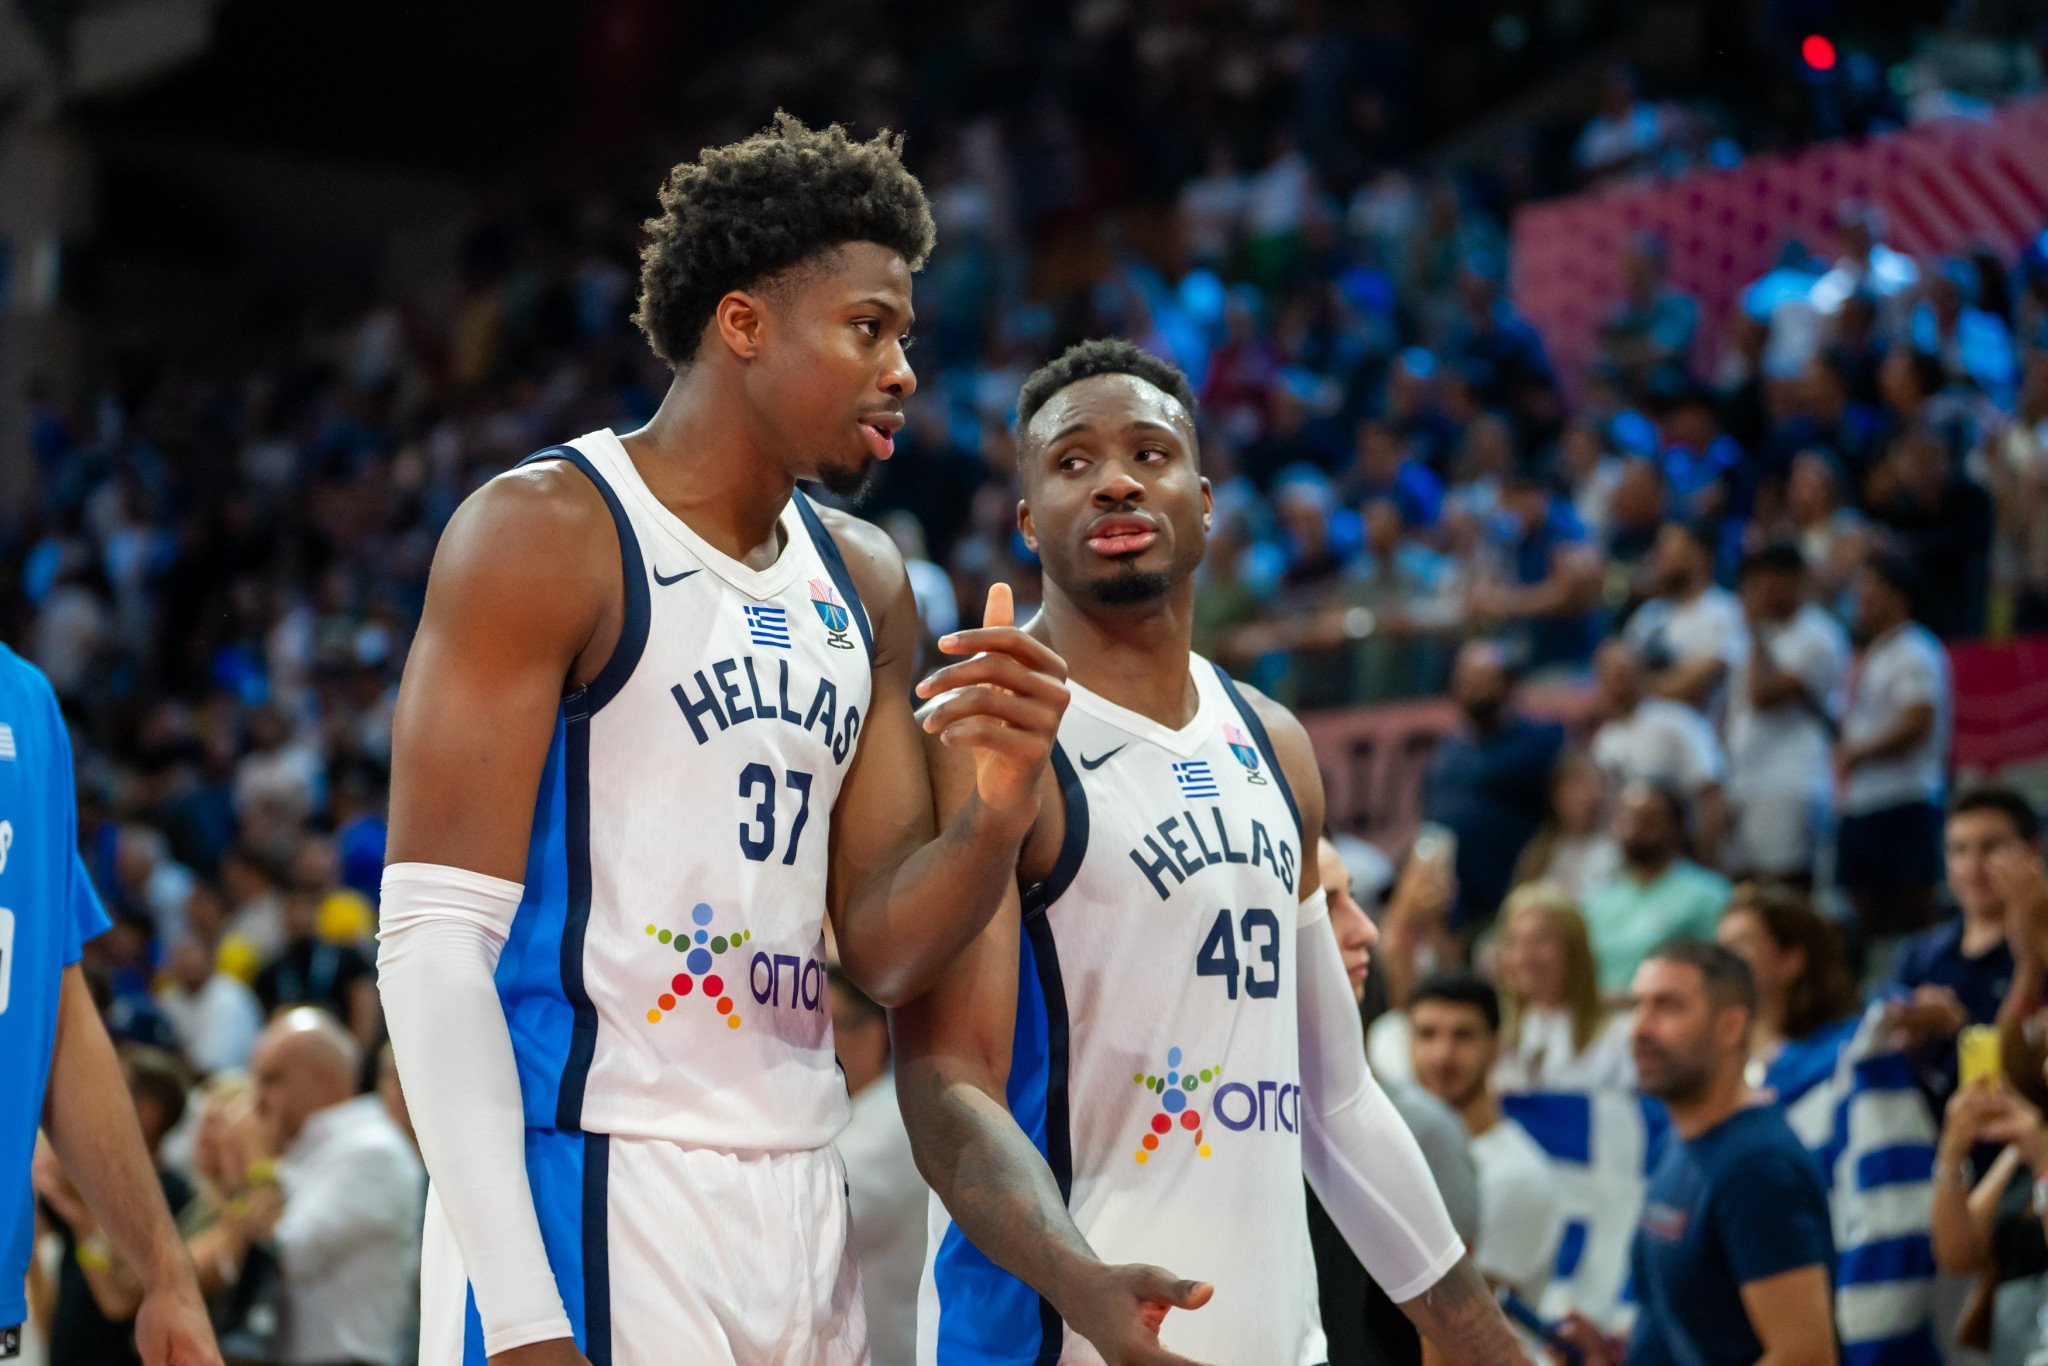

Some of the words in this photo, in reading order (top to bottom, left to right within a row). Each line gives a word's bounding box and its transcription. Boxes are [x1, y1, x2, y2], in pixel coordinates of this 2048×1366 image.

[671, 656, 859, 765] HELLAS
[739, 762, 813, 866] 37
[1129, 806, 1294, 901] HELLAS
[1196, 908, 1280, 1000] 43
